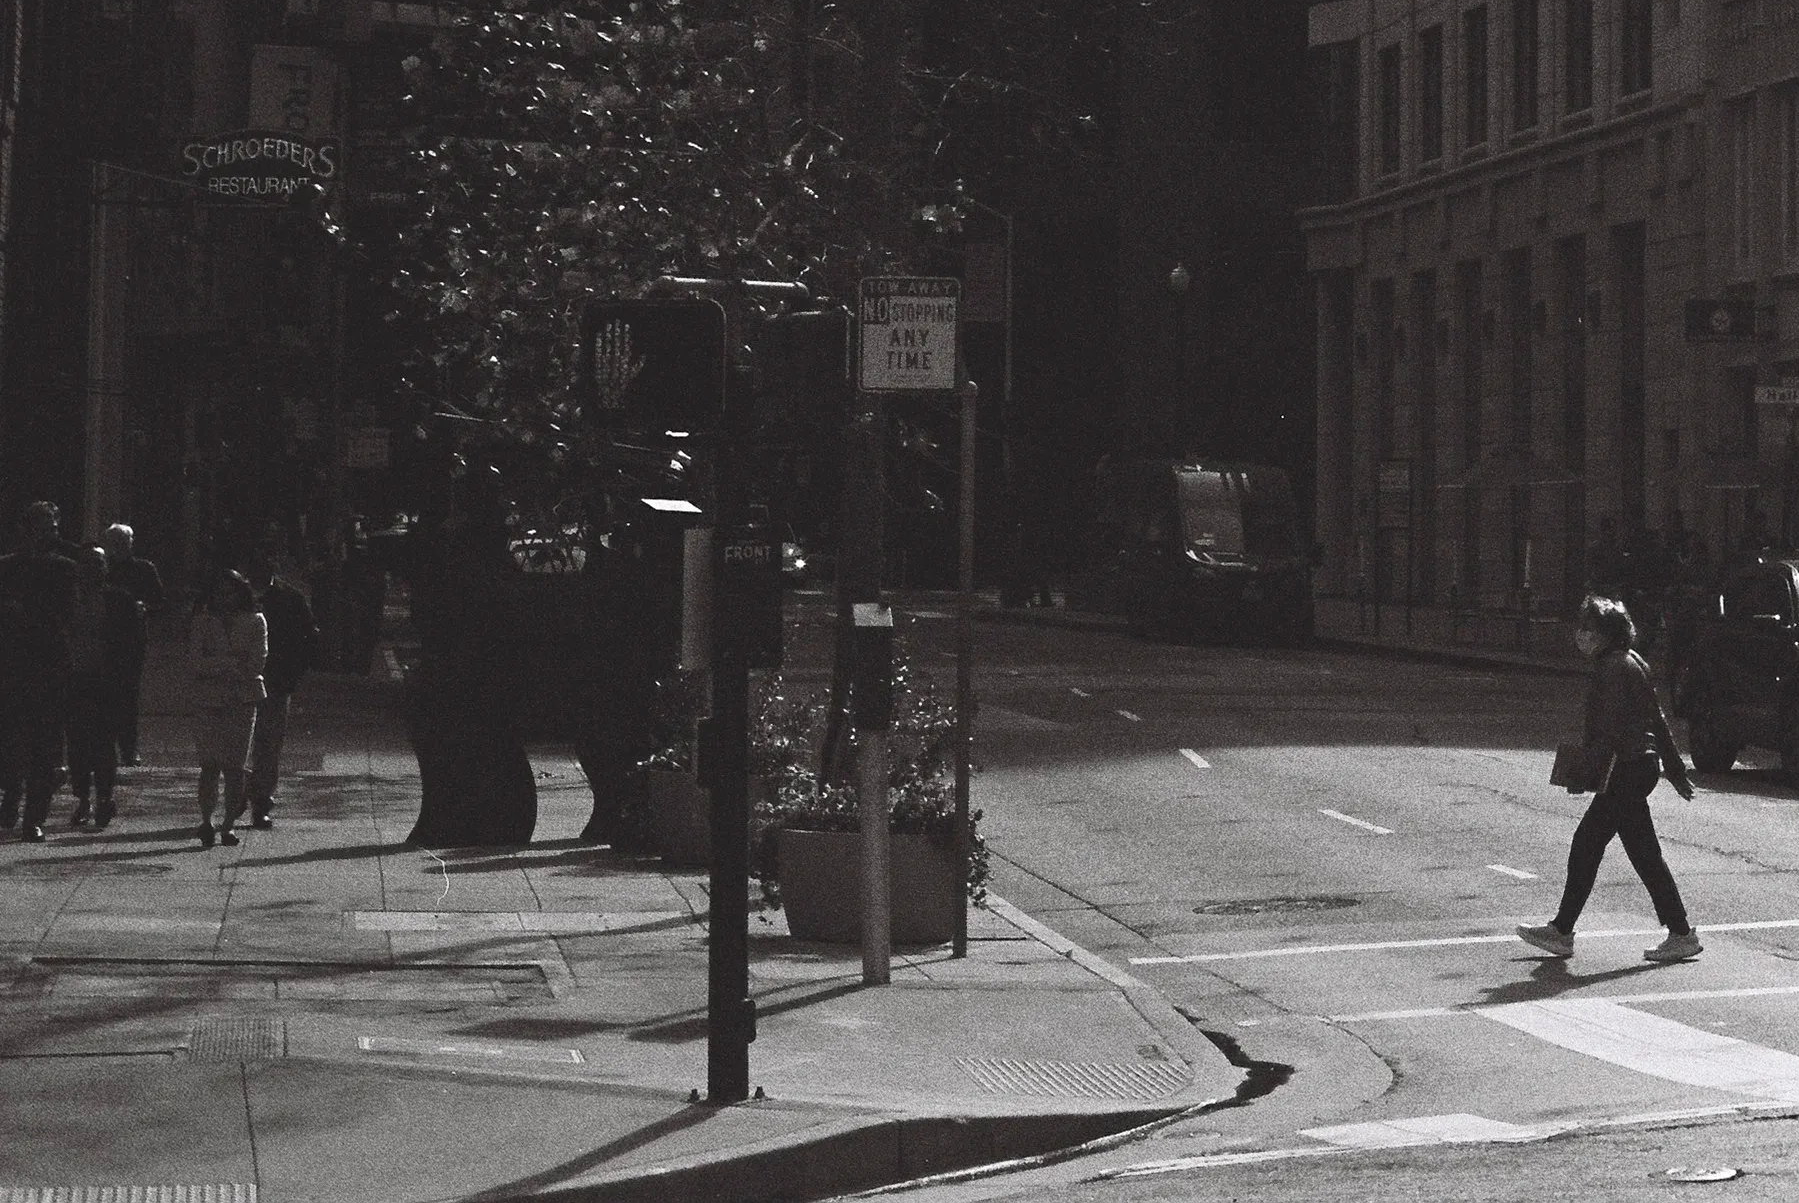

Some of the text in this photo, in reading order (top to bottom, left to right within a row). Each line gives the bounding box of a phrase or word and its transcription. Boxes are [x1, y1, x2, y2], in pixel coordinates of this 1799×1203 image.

[279, 63, 313, 131] FRO
[183, 138, 335, 178] SCHROEDERS
[863, 296, 954, 322] NO STOPPING
[889, 329, 929, 347] ANY
[886, 351, 932, 370] TIME
[723, 545, 772, 564] FRONT
